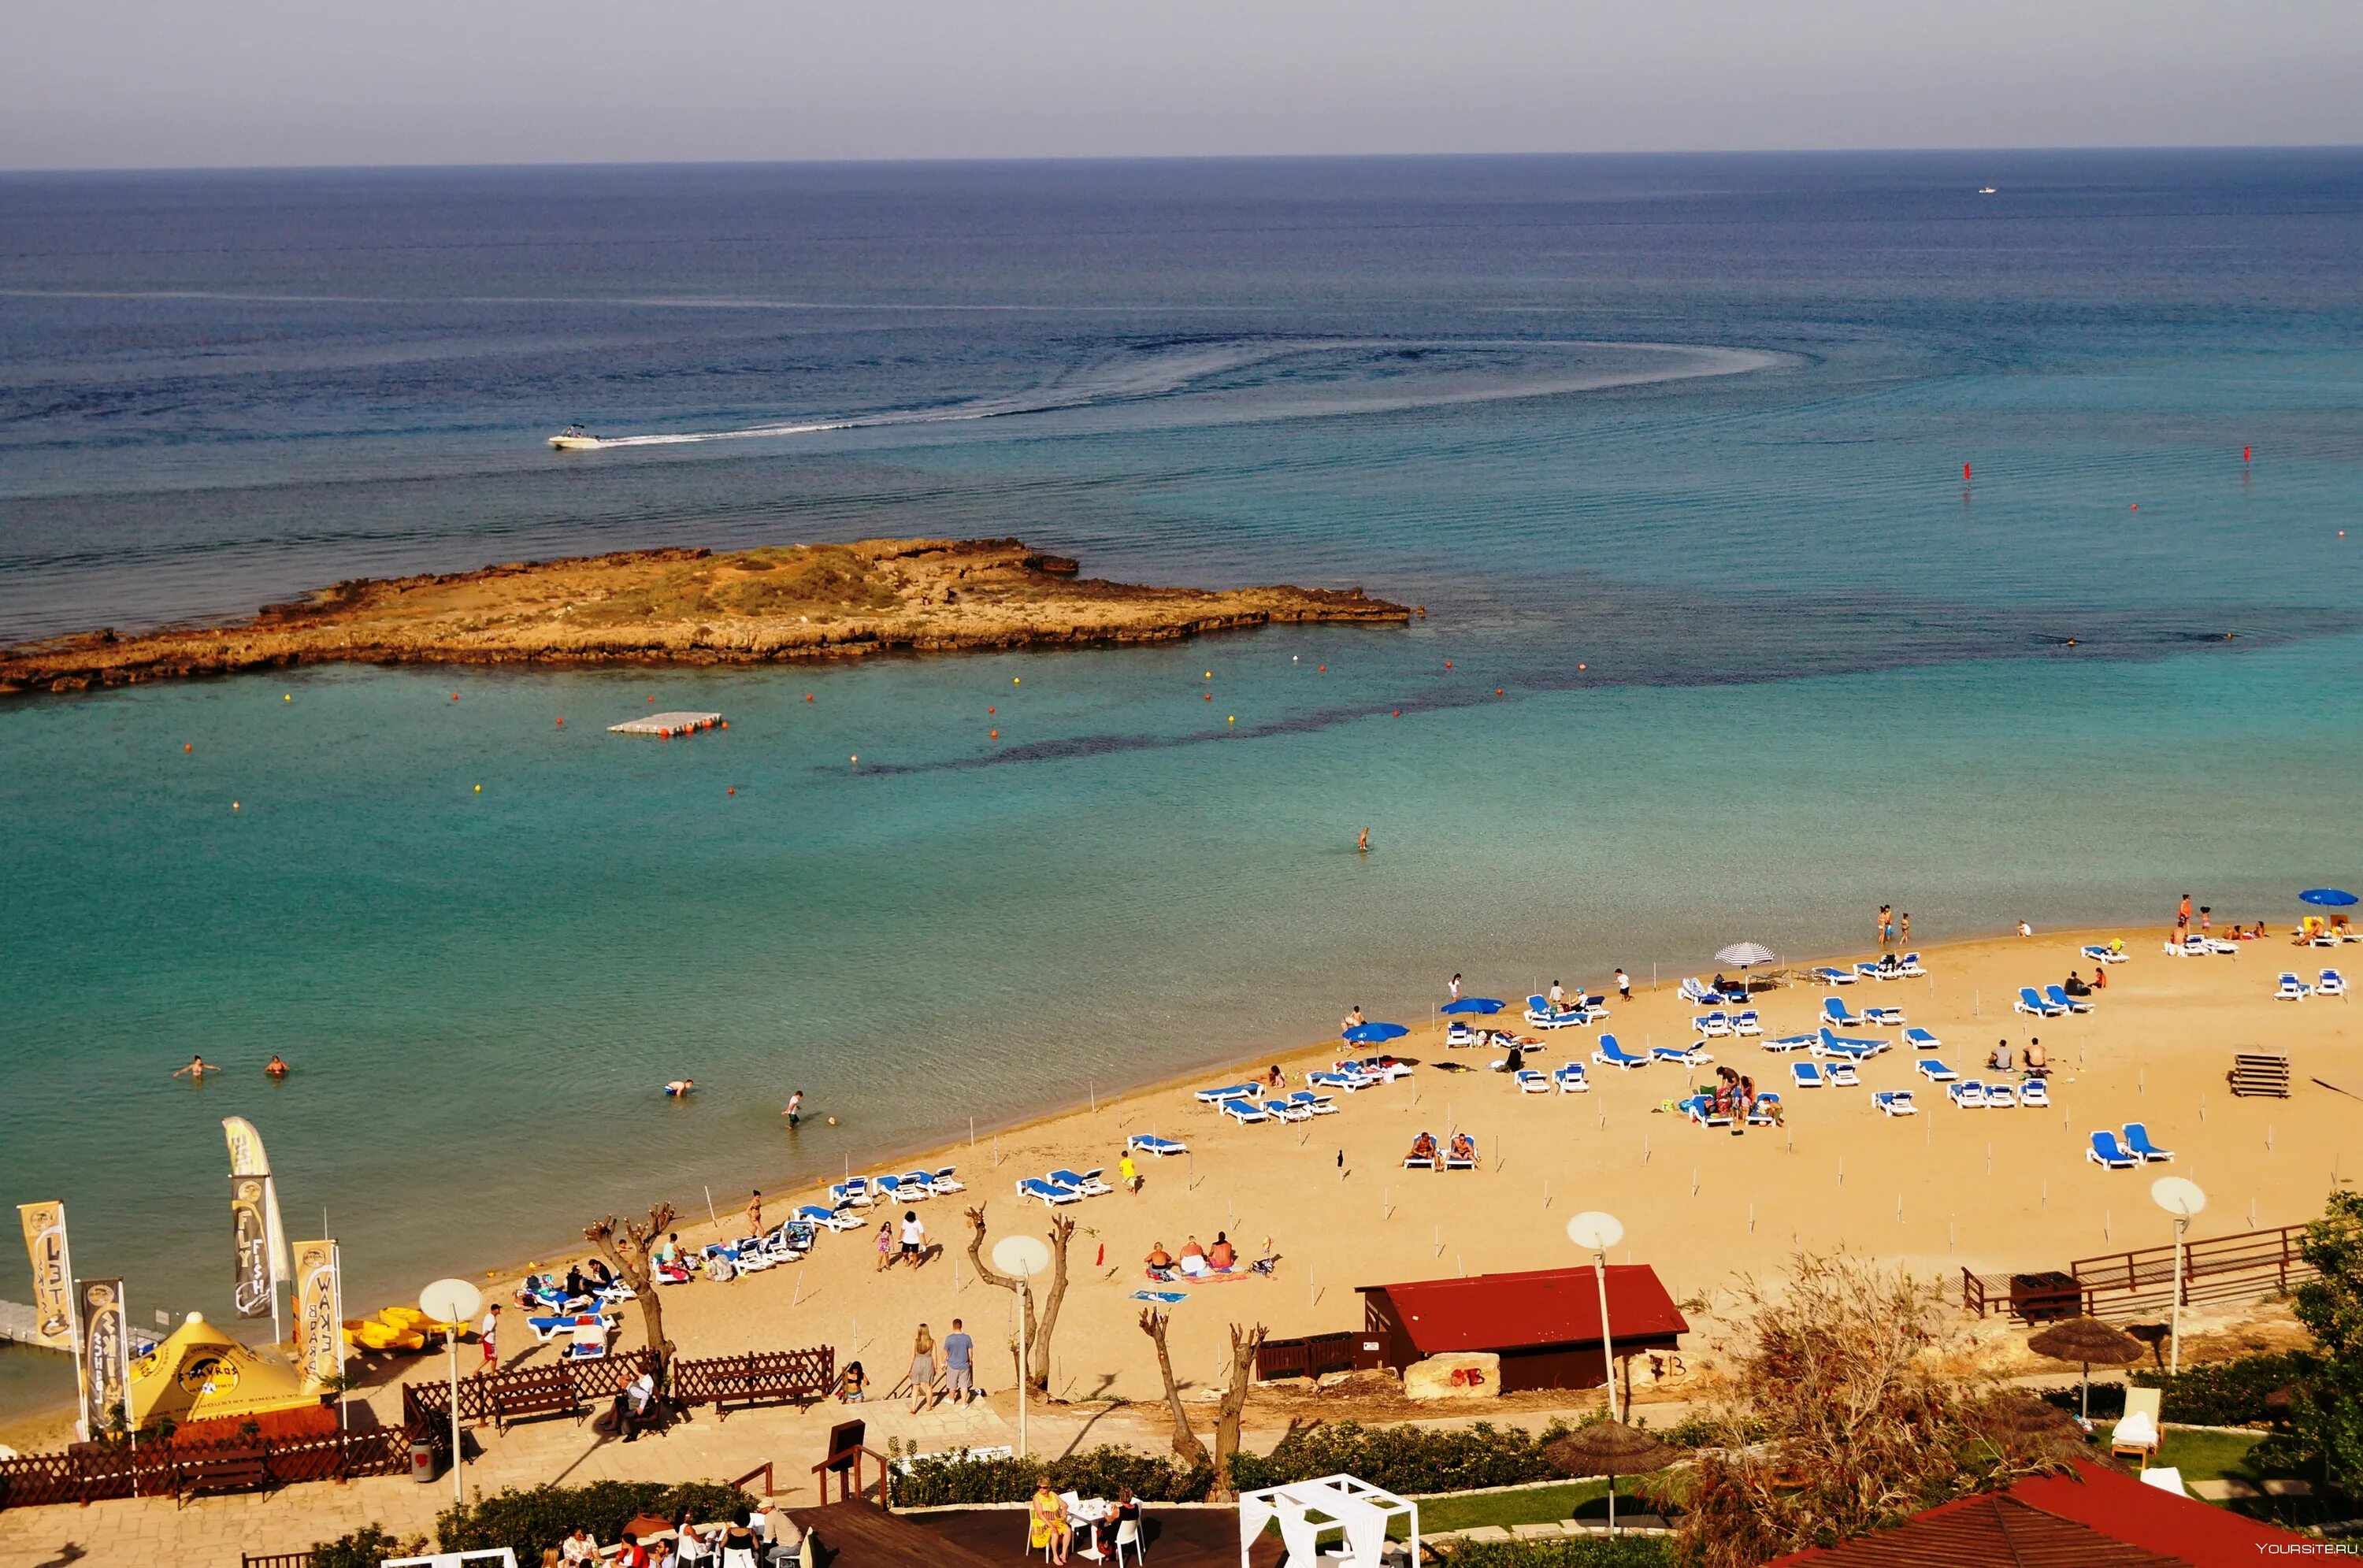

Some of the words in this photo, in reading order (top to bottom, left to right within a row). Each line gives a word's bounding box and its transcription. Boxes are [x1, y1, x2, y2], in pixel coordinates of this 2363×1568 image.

[238, 1210, 252, 1268] FLY
[253, 1239, 265, 1295] FISH
[178, 1366, 238, 1383] STAVROS
